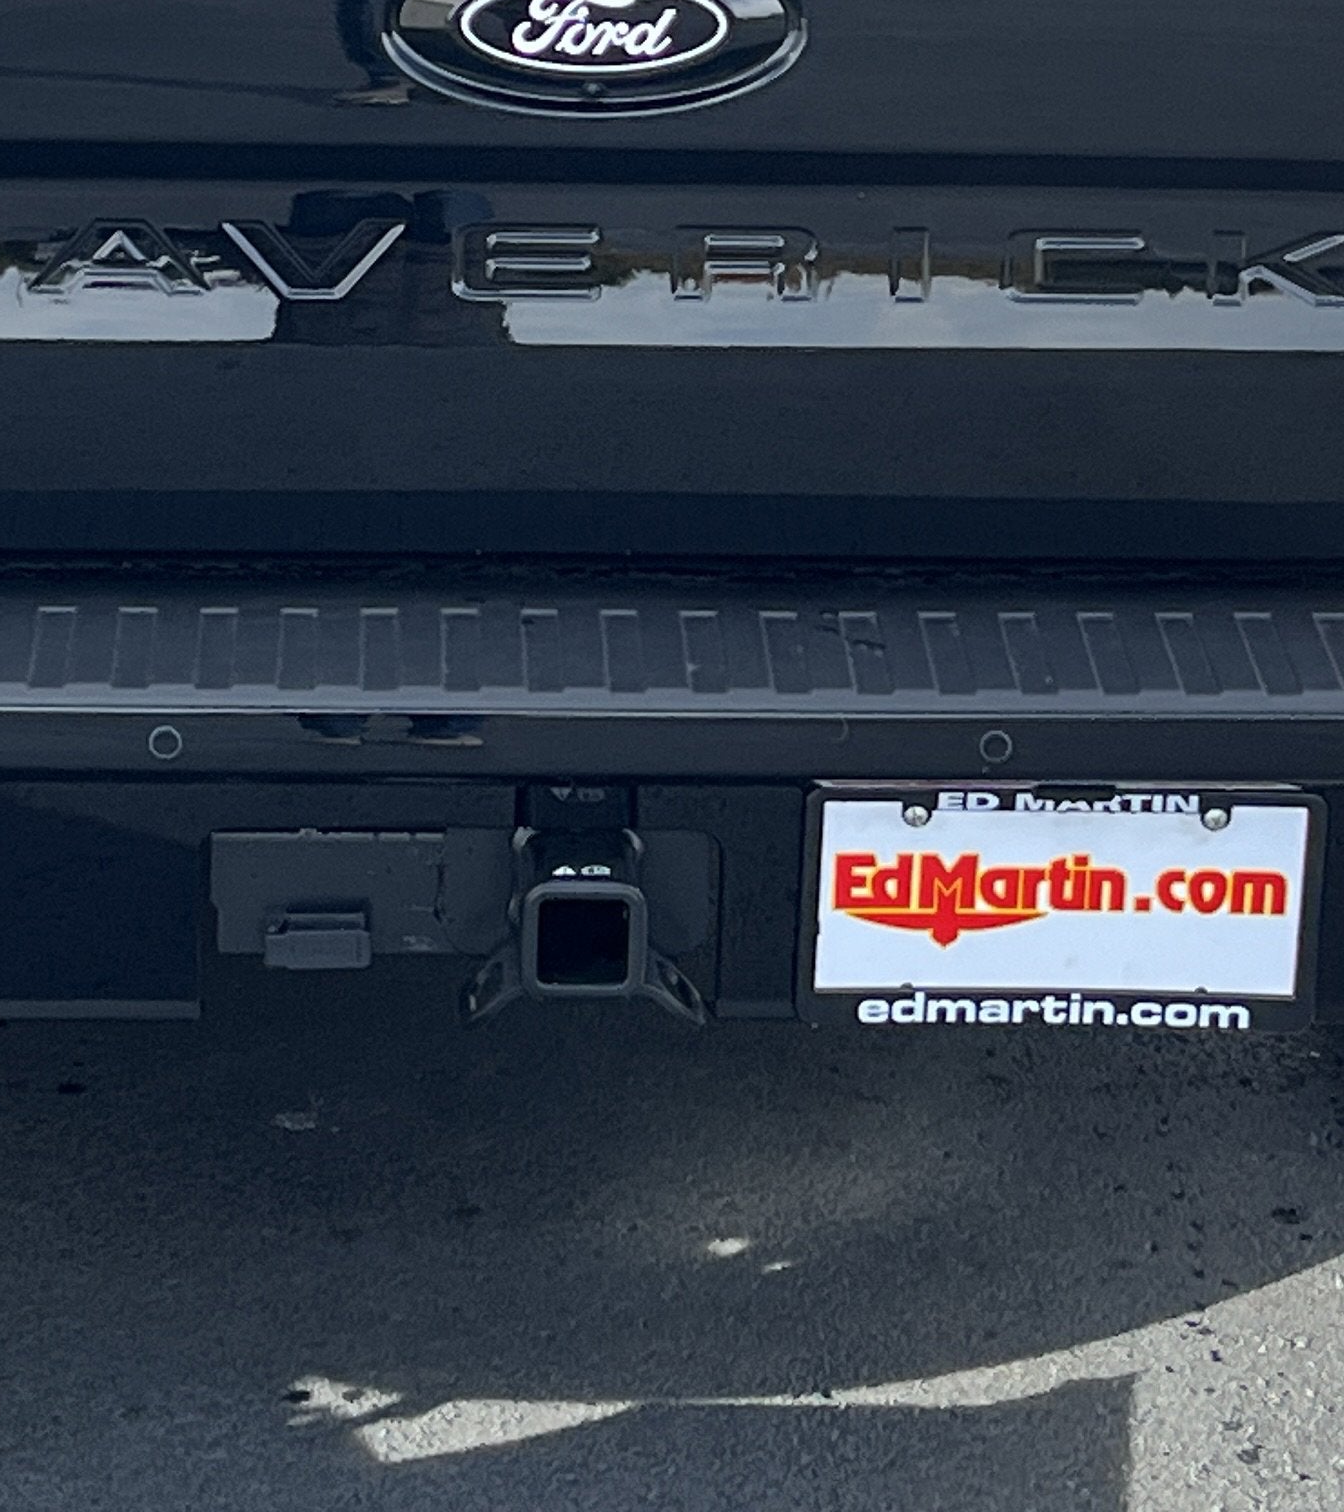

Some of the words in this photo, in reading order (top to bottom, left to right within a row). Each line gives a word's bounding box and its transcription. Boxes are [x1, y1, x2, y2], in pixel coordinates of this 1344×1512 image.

[937, 791, 1001, 811] ED
[831, 852, 1288, 916] EdMartin.com
[856, 993, 1251, 1030] edmartin.com
